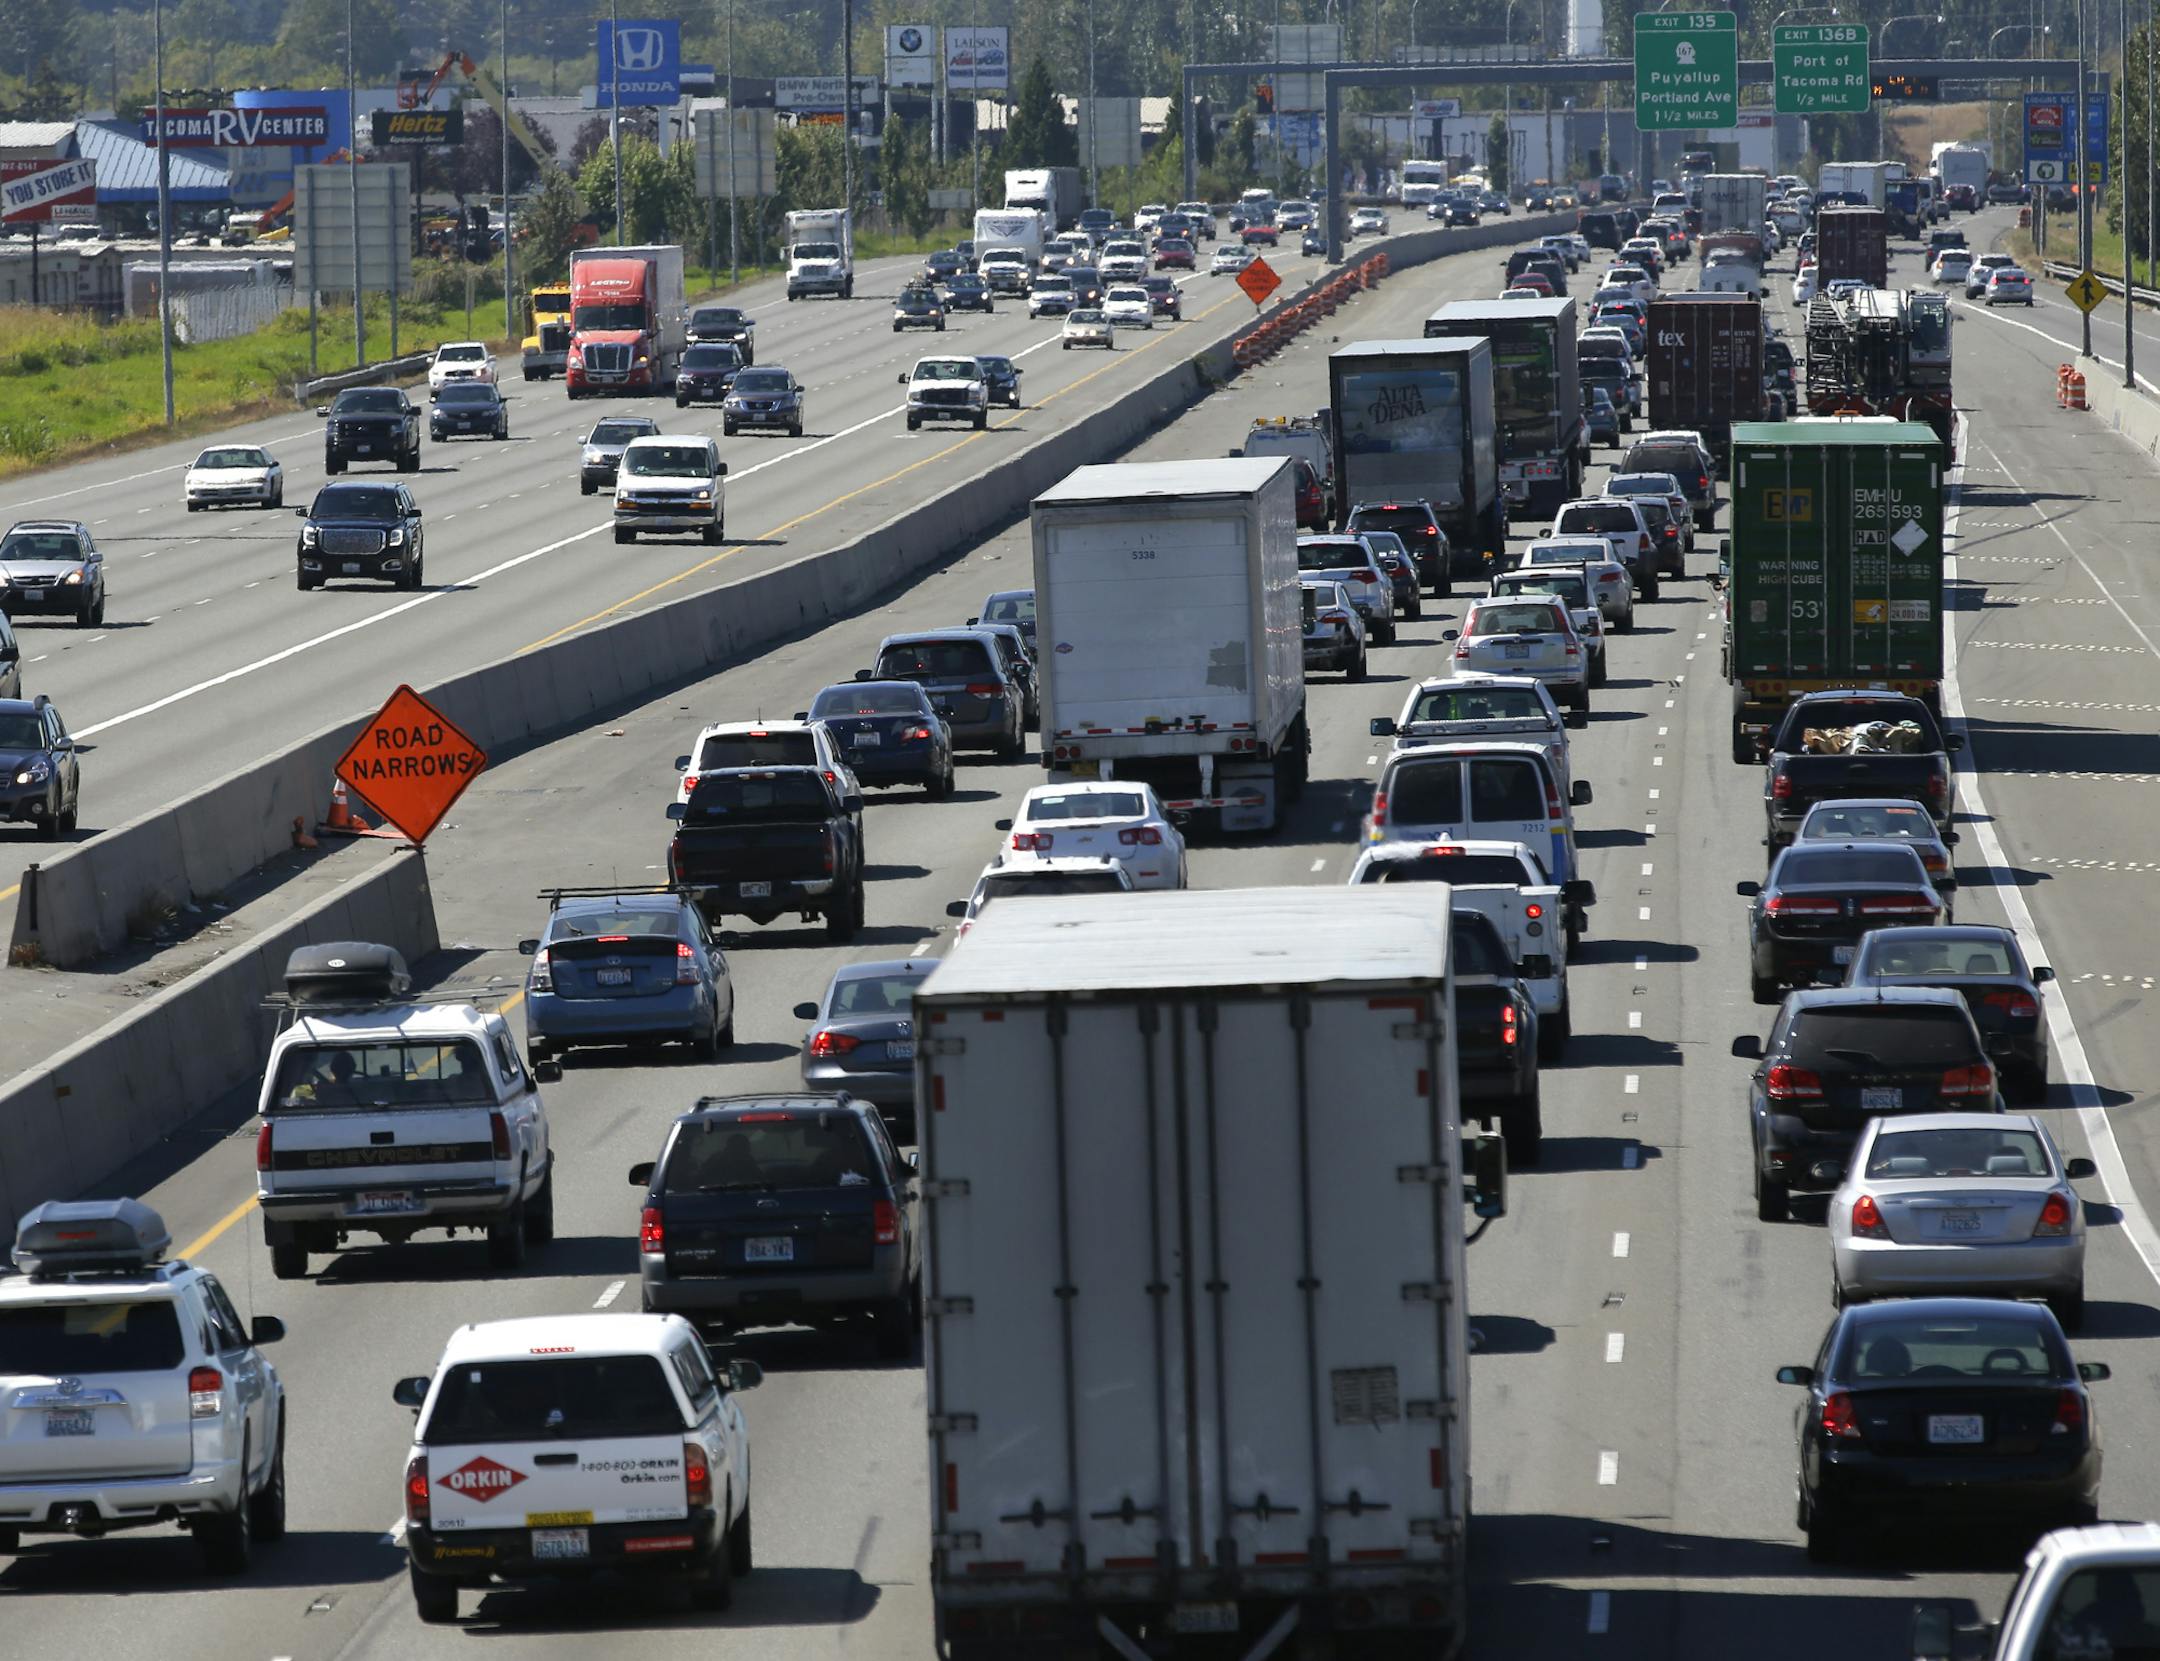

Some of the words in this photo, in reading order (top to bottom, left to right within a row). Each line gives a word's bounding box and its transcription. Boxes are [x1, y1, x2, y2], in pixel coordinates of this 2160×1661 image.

[1655, 17, 1680, 27] EXIT
[1689, 15, 1716, 28] 135
[1784, 31, 1808, 40] EXIT
[1818, 28, 1857, 41] 136B
[1678, 47, 1692, 55] 167
[1793, 55, 1826, 67] Port
[1835, 55, 1849, 66] of
[1650, 71, 1721, 85] Puyallup
[1781, 75, 1839, 87] Tacoma
[1844, 74, 1863, 86] Rd
[601, 81, 676, 92] HONDA
[1641, 91, 1700, 104] Portland
[1704, 90, 1731, 102] Ave
[1797, 93, 1814, 106] 1/2
[1821, 94, 1848, 104] MILE
[1687, 110, 1719, 120] MILES
[207, 109, 263, 145] RV
[262, 118, 325, 135] CENTER
[388, 114, 448, 133] Hertz
[5, 181, 34, 206] YOU
[35, 166, 76, 196] STORE
[78, 162, 92, 182] IT
[1657, 329, 1685, 347] tex
[1377, 384, 1422, 405] ALTA
[1368, 399, 1427, 424] DENA
[1758, 574, 1787, 584] HIGH
[1791, 574, 1823, 584] CUBE
[375, 724, 444, 749] ROAD
[352, 752, 472, 780] NARROWS
[1522, 823, 1545, 833] 7212
[449, 1469, 513, 1489] ORKIN
[620, 1473, 681, 1484] Orkin.com
